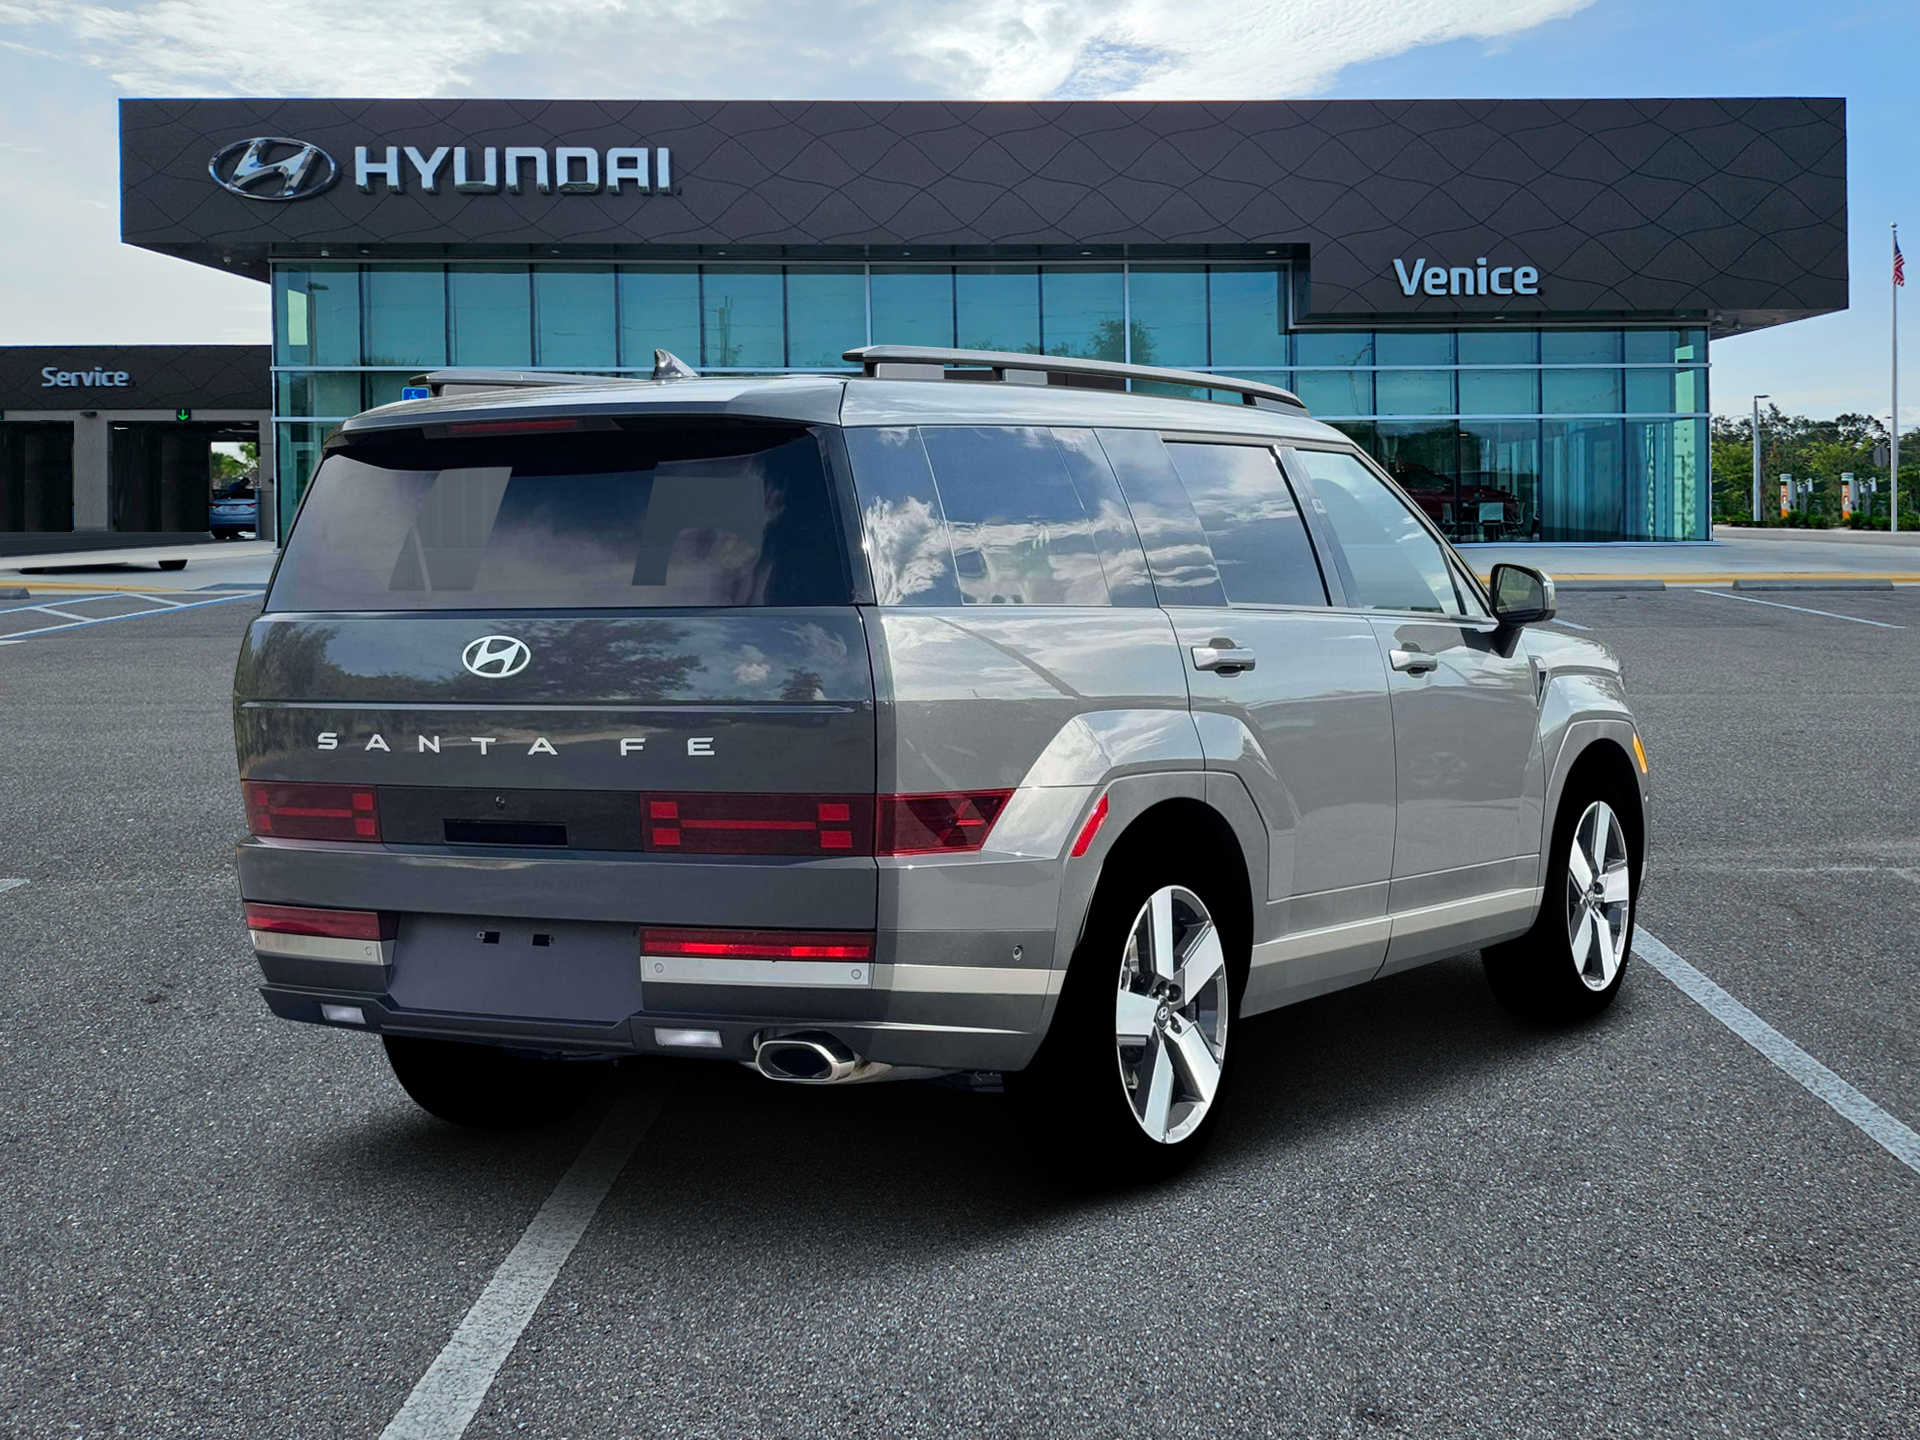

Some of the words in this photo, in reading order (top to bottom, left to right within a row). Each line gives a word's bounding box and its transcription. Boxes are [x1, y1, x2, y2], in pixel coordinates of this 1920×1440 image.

[354, 146, 673, 194] HYUNDAI
[1393, 257, 1539, 296] Venice
[41, 366, 130, 388] Service
[317, 732, 558, 756] SANTA
[620, 737, 715, 756] FE
